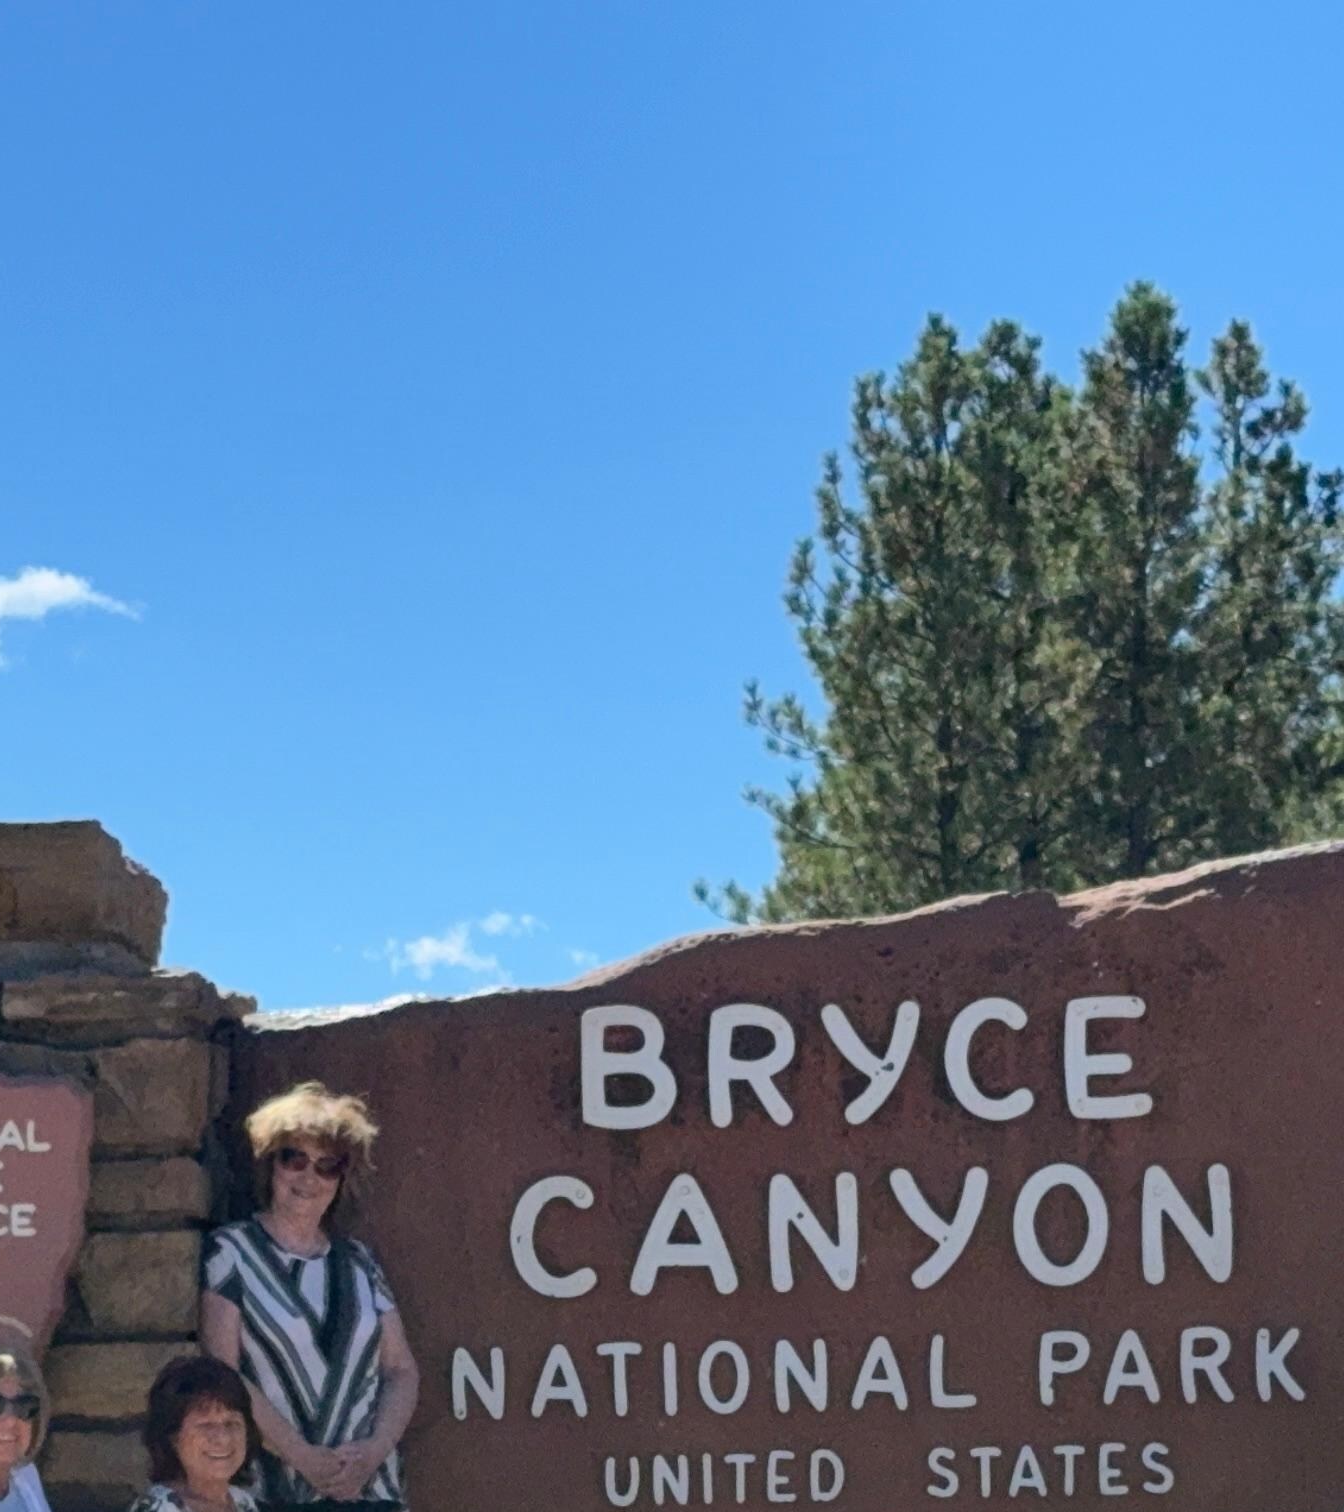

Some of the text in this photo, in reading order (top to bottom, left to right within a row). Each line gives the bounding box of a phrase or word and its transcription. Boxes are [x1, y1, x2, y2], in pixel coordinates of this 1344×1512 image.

[579, 995, 1154, 1130] BRYCE
[509, 1163, 1234, 1298] CANYON
[452, 1325, 1306, 1421] NATIONAL PARK
[604, 1441, 1175, 1507] UNITED STATES
